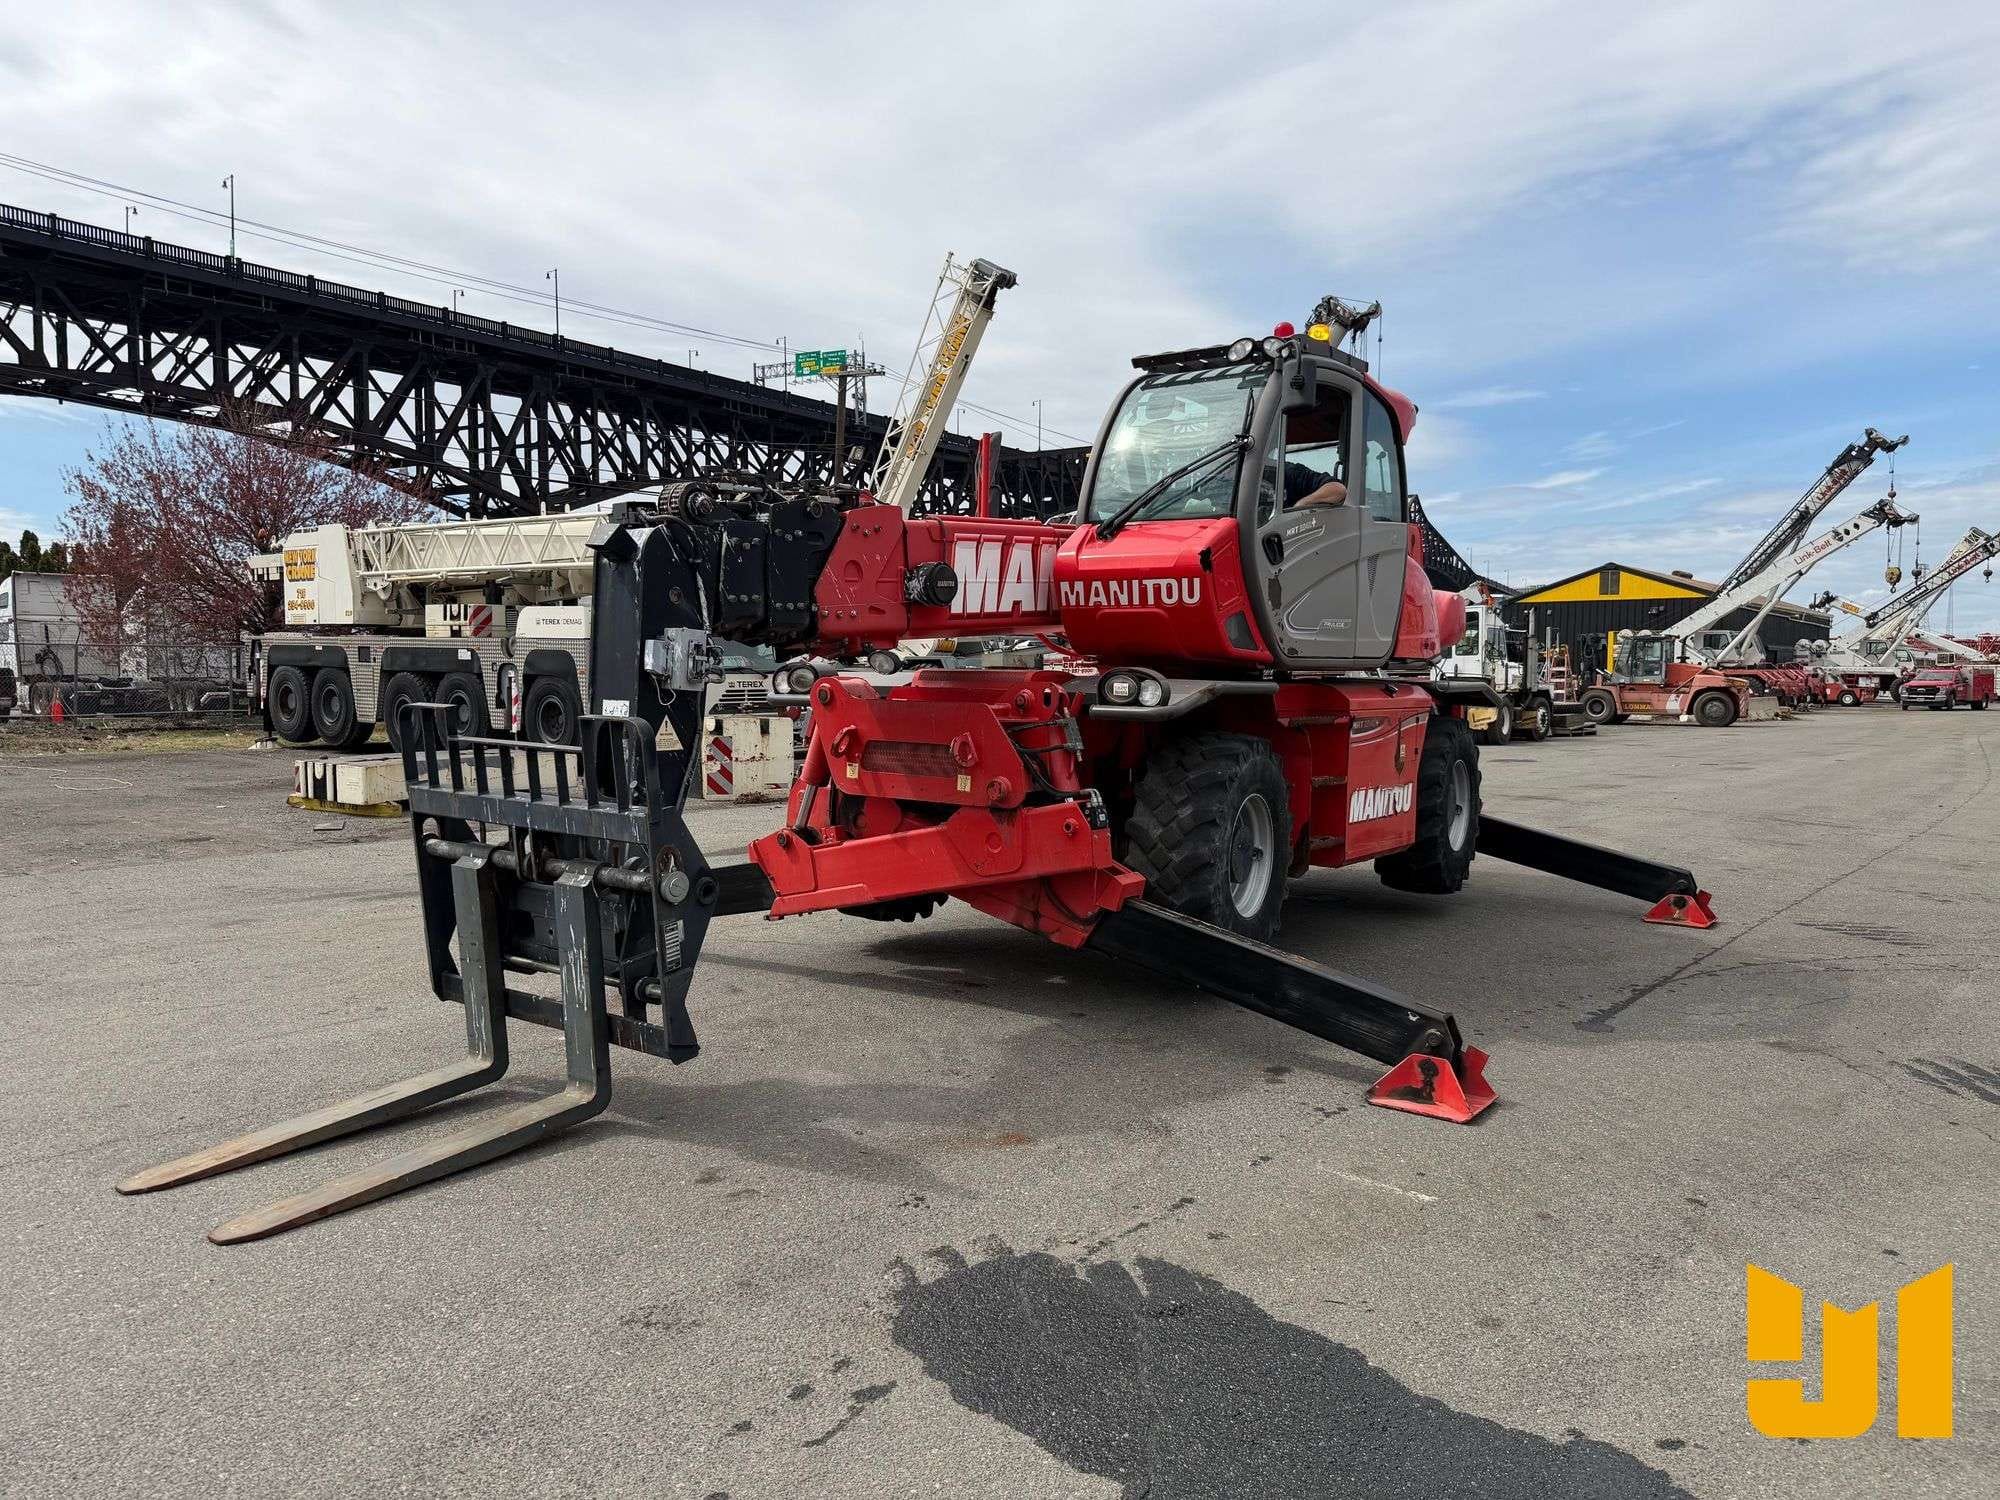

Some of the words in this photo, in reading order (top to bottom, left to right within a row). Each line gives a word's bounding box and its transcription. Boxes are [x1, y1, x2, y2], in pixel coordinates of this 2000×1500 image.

[1794, 539, 1833, 566] Link-Belt
[286, 565, 316, 581] CRANE
[1060, 577, 1200, 607] MANITOU
[736, 680, 764, 688] TEREX
[1349, 782, 1413, 823] MANITOU
